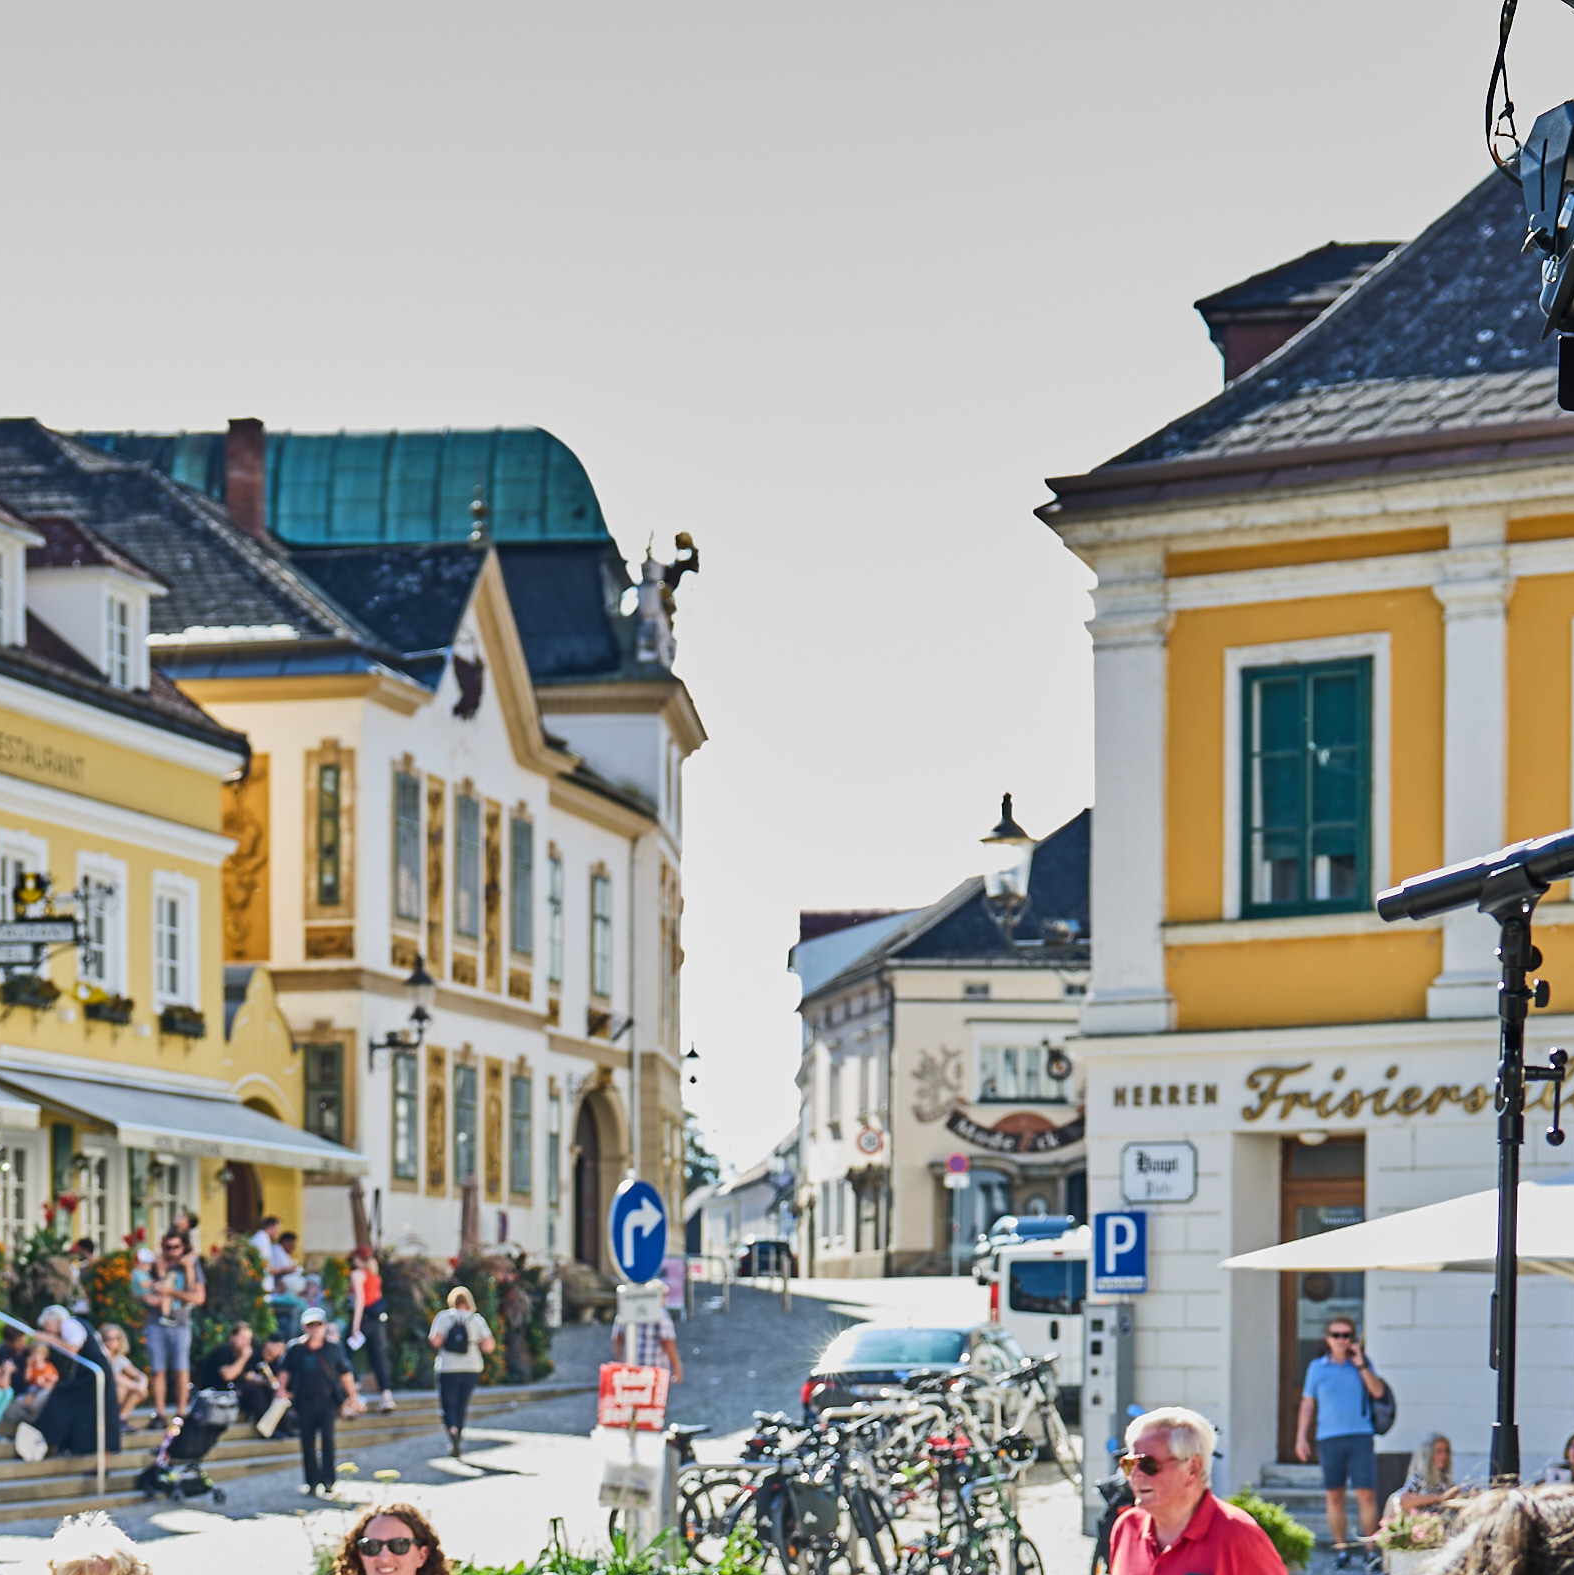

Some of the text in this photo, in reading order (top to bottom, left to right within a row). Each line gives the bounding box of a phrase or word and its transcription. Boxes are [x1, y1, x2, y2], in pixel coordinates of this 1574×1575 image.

[1113, 1083, 1219, 1108] HERREN
[955, 1119, 1015, 1149] Mode
[1105, 1214, 1138, 1274] P
